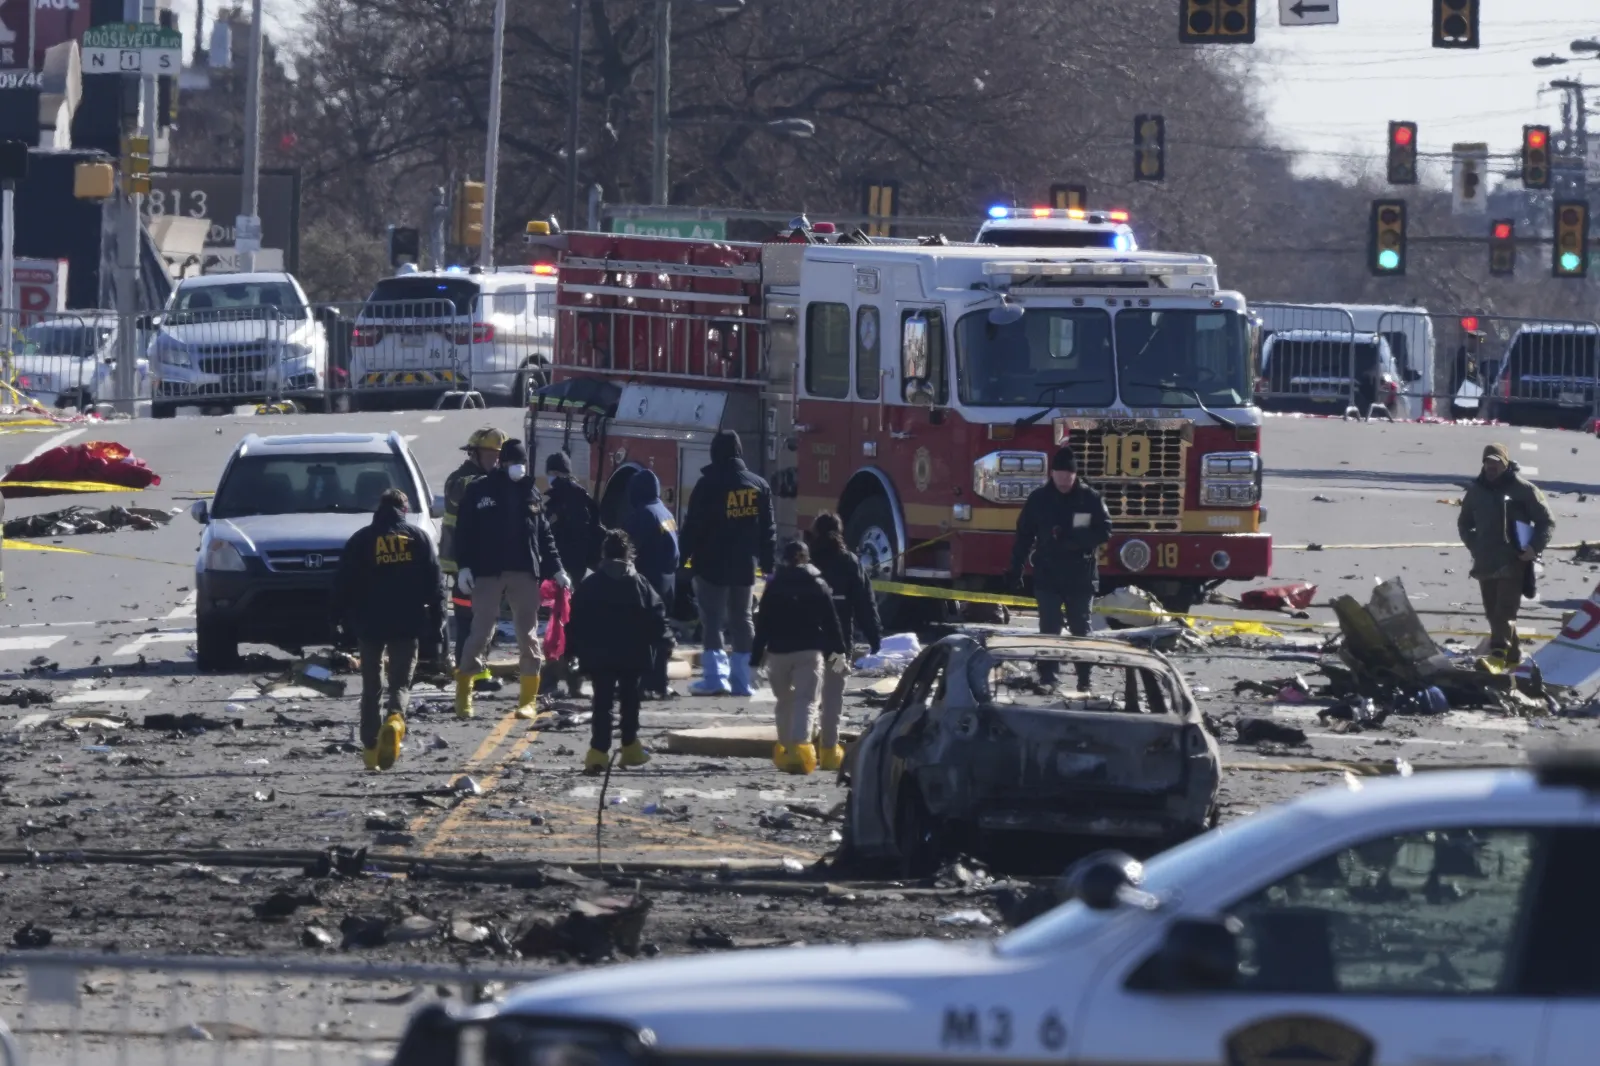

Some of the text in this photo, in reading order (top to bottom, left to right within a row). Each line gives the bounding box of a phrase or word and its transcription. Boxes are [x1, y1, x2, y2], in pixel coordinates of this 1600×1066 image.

[83, 30, 158, 47] ROOSEVELT
[92, 53, 104, 66] N
[159, 54, 171, 67] S
[1102, 434, 1151, 476] 18
[818, 459, 830, 483] 18
[727, 488, 757, 508] ATF
[727, 506, 759, 518] POLICE
[376, 535, 408, 555] ATF
[376, 552, 412, 564] POLICE
[1157, 543, 1179, 568] 18
